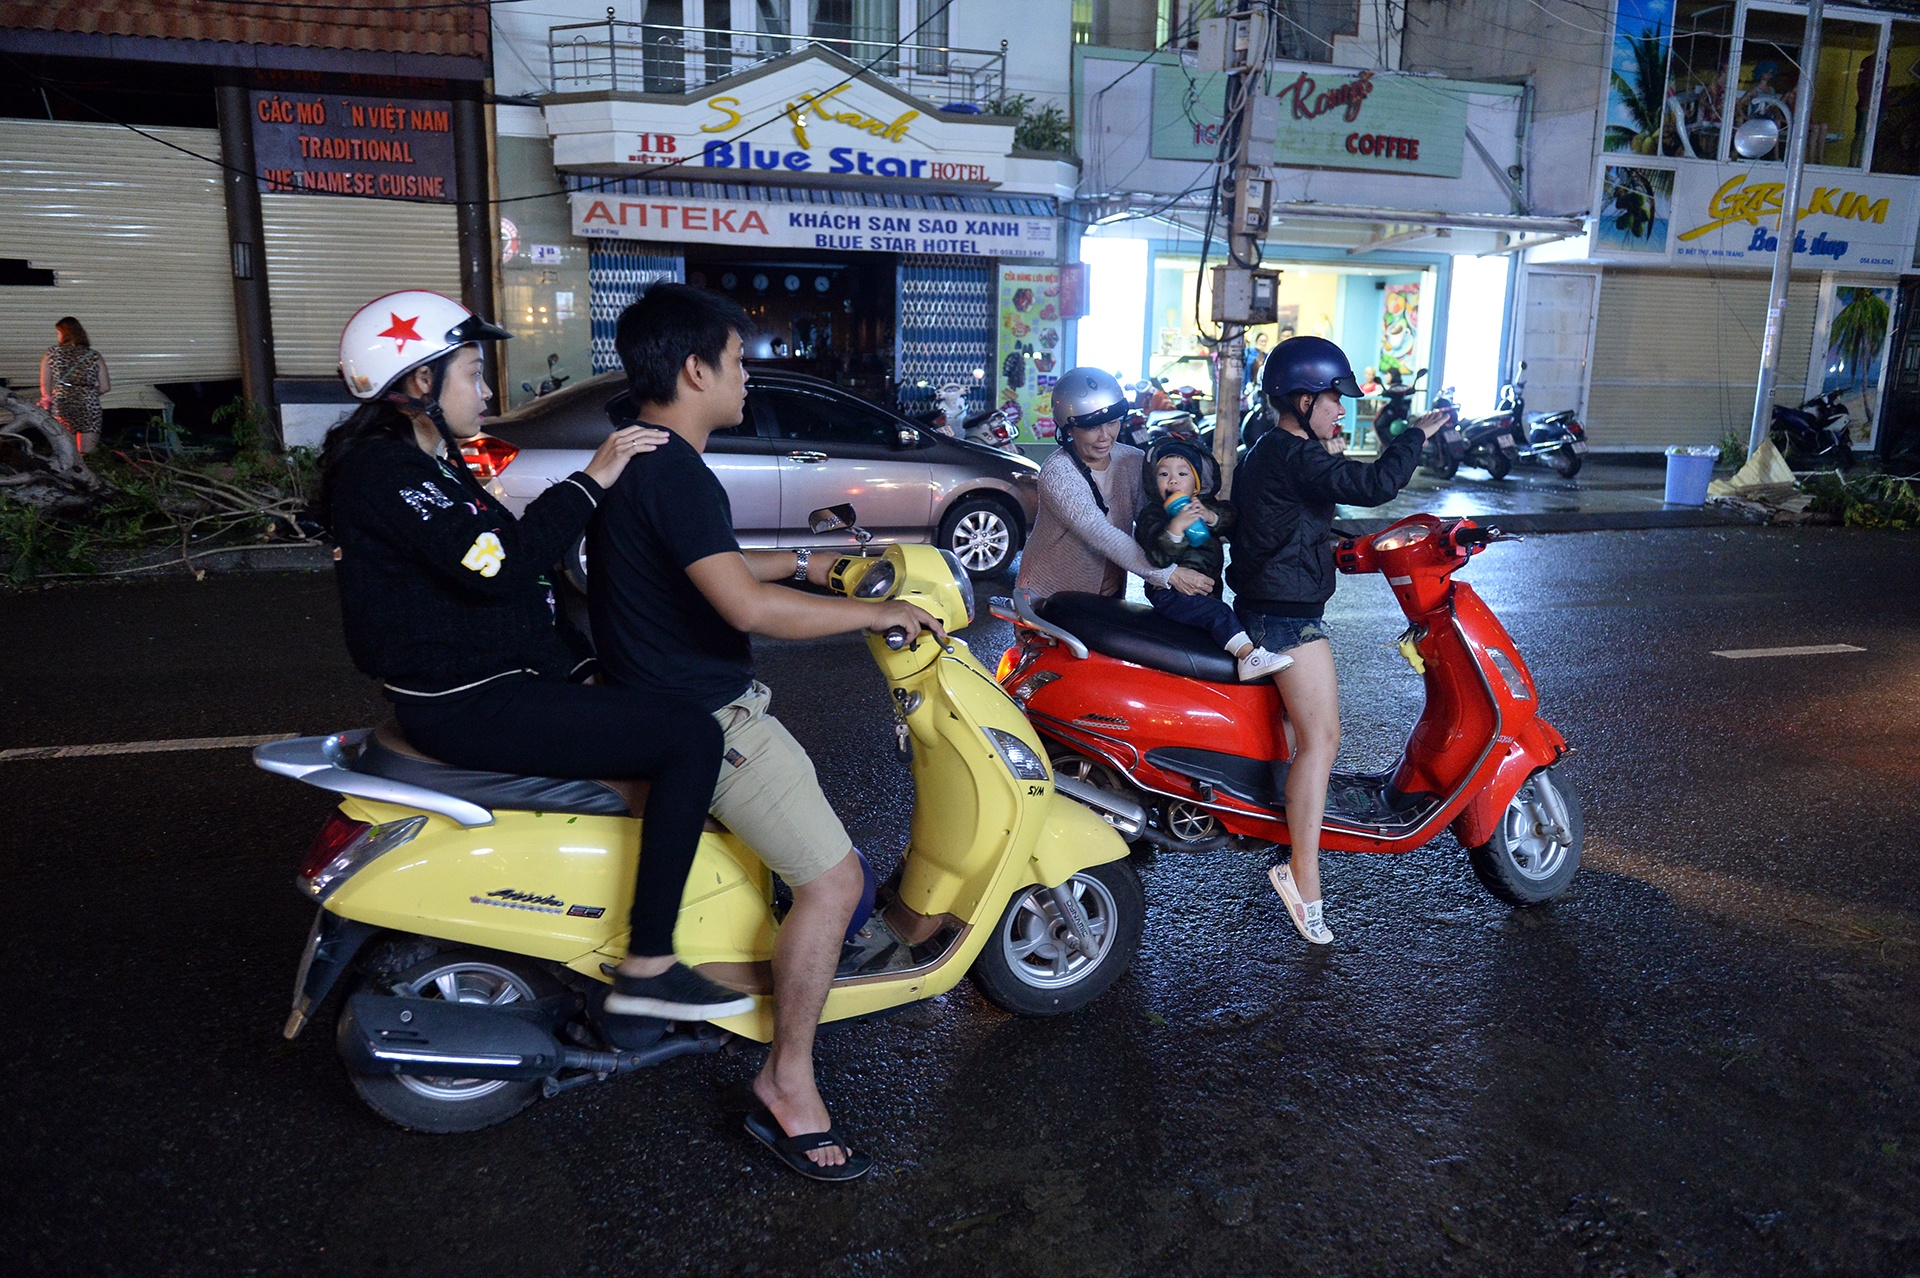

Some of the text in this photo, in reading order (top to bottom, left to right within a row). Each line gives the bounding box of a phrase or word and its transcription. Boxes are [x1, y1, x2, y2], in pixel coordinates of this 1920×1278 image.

[257, 96, 293, 124] CÁC
[368, 103, 407, 134] VIỆT
[410, 110, 450, 133] NAM
[797, 84, 920, 143] Xanh
[298, 136, 415, 163] TRADITIONAL
[637, 133, 677, 153] 1B
[1346, 132, 1420, 161] COFFEE
[703, 140, 928, 178] Blue Star
[930, 162, 990, 182] HOTEL
[378, 175, 446, 198] CUISINE
[582, 201, 770, 235] АПТЕКА
[1808, 187, 1890, 224] KIM
[789, 210, 861, 230] KHÁCH
[868, 217, 911, 235] SẠN
[918, 218, 958, 235] SAO
[965, 220, 1020, 237] XANH
[815, 233, 981, 255] BLUE STAR HOTEL
[1725, 250, 1744, 258] TRANG
[1027, 785, 1045, 796] SYM
